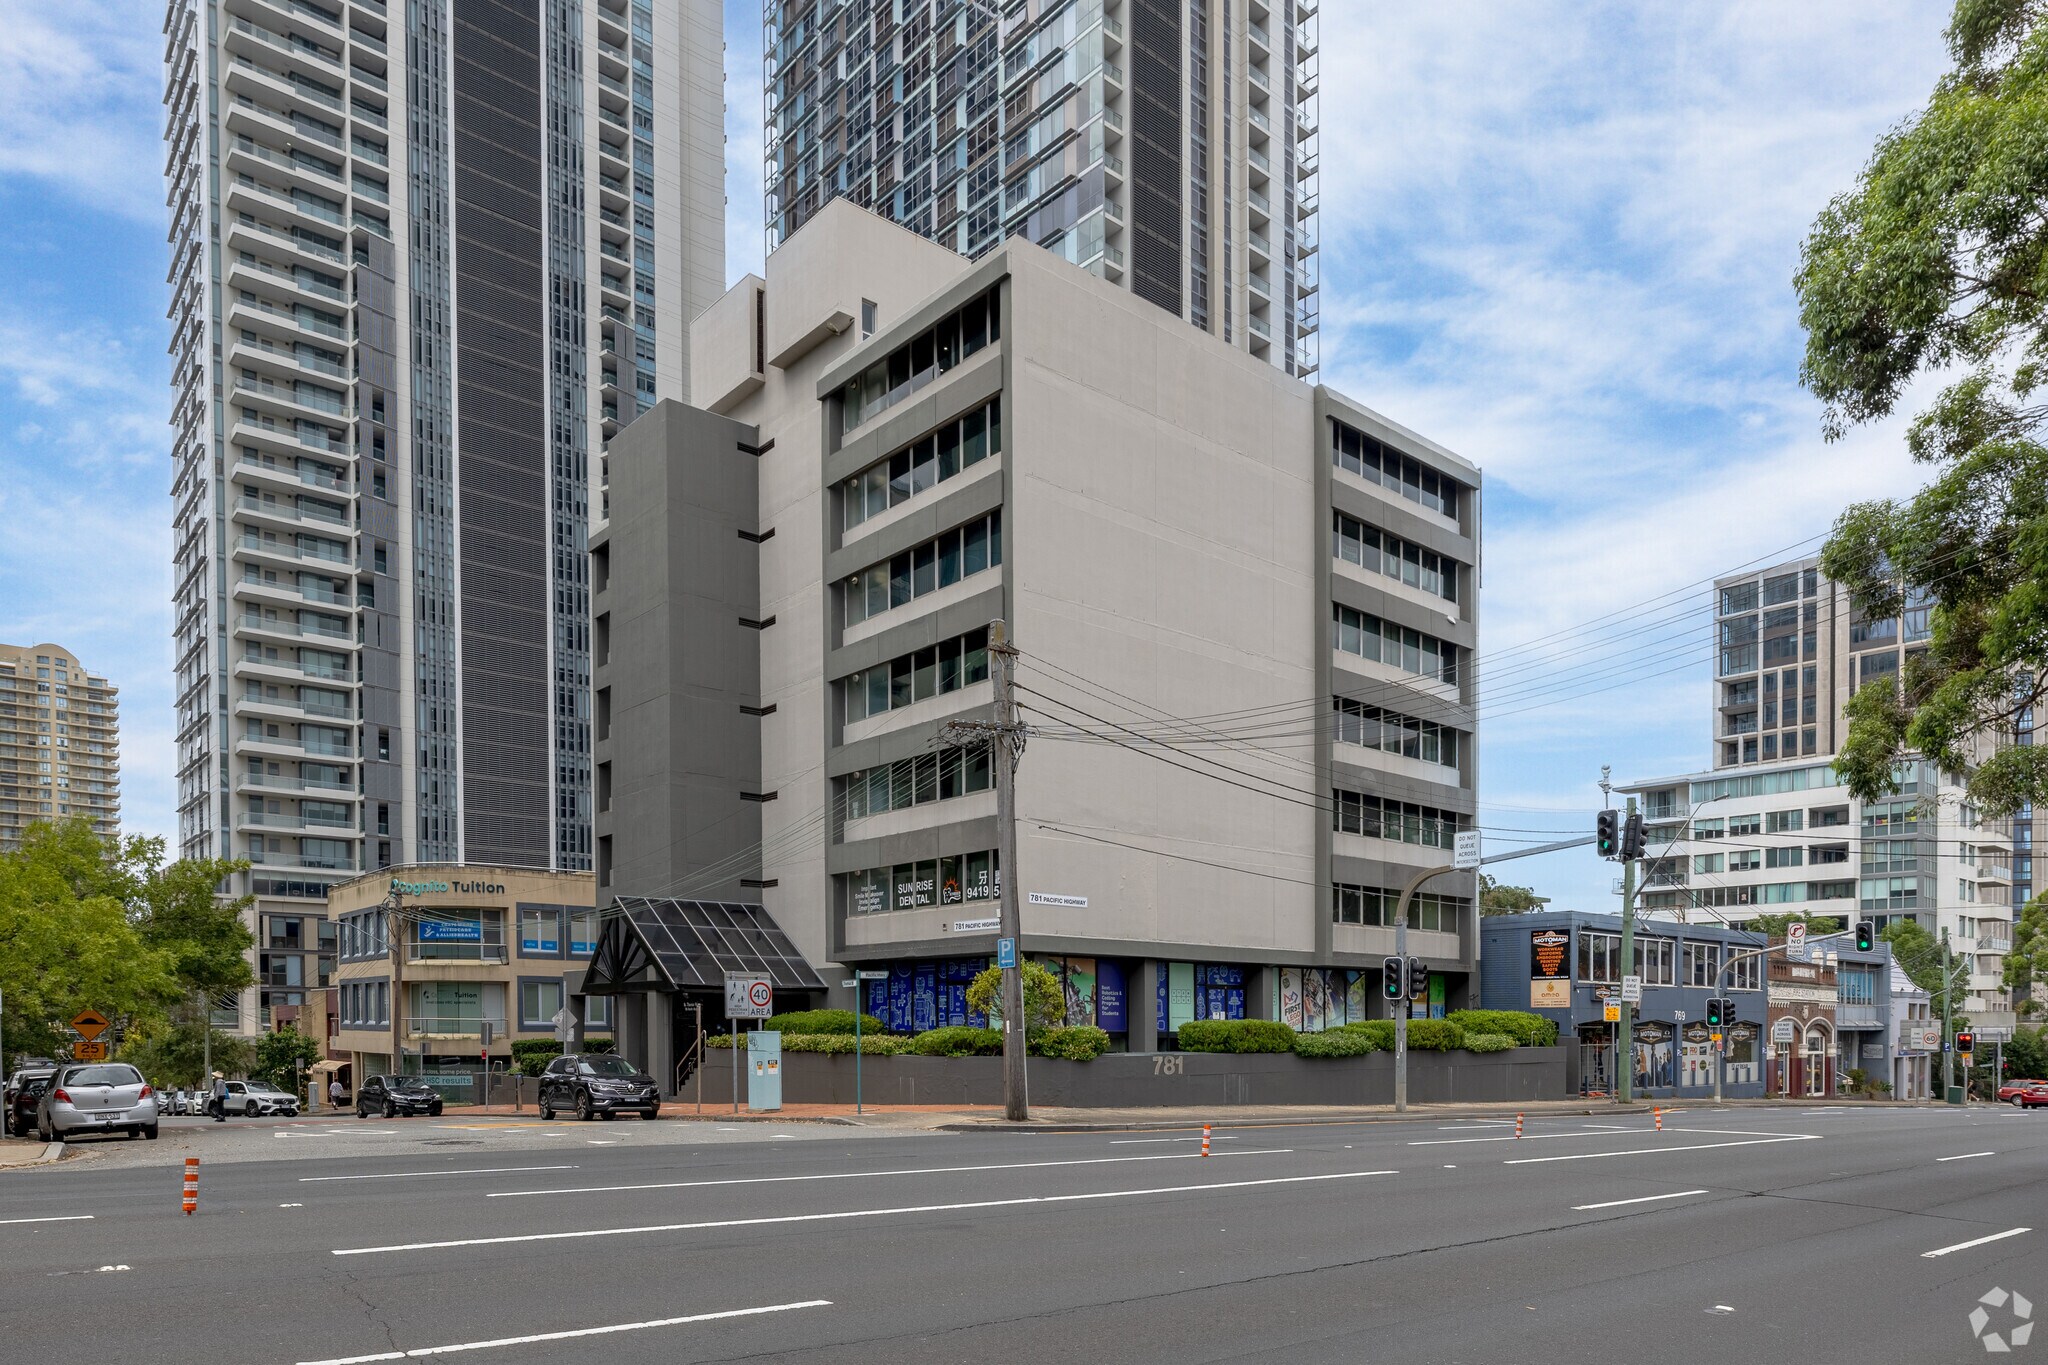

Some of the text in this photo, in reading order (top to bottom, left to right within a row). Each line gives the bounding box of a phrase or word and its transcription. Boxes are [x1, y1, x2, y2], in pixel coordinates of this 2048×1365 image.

[398, 880, 505, 896] Cognito Tuition
[967, 886, 988, 898] 9419
[1030, 894, 1042, 902] 781
[1001, 940, 1010, 957] P
[753, 989, 768, 1000] 40
[750, 1008, 771, 1016] AREA
[1284, 1003, 1300, 1016] FIRST
[1674, 1010, 1686, 1020] 769
[81, 1044, 99, 1053] 25
[1152, 1055, 1184, 1075] 781
